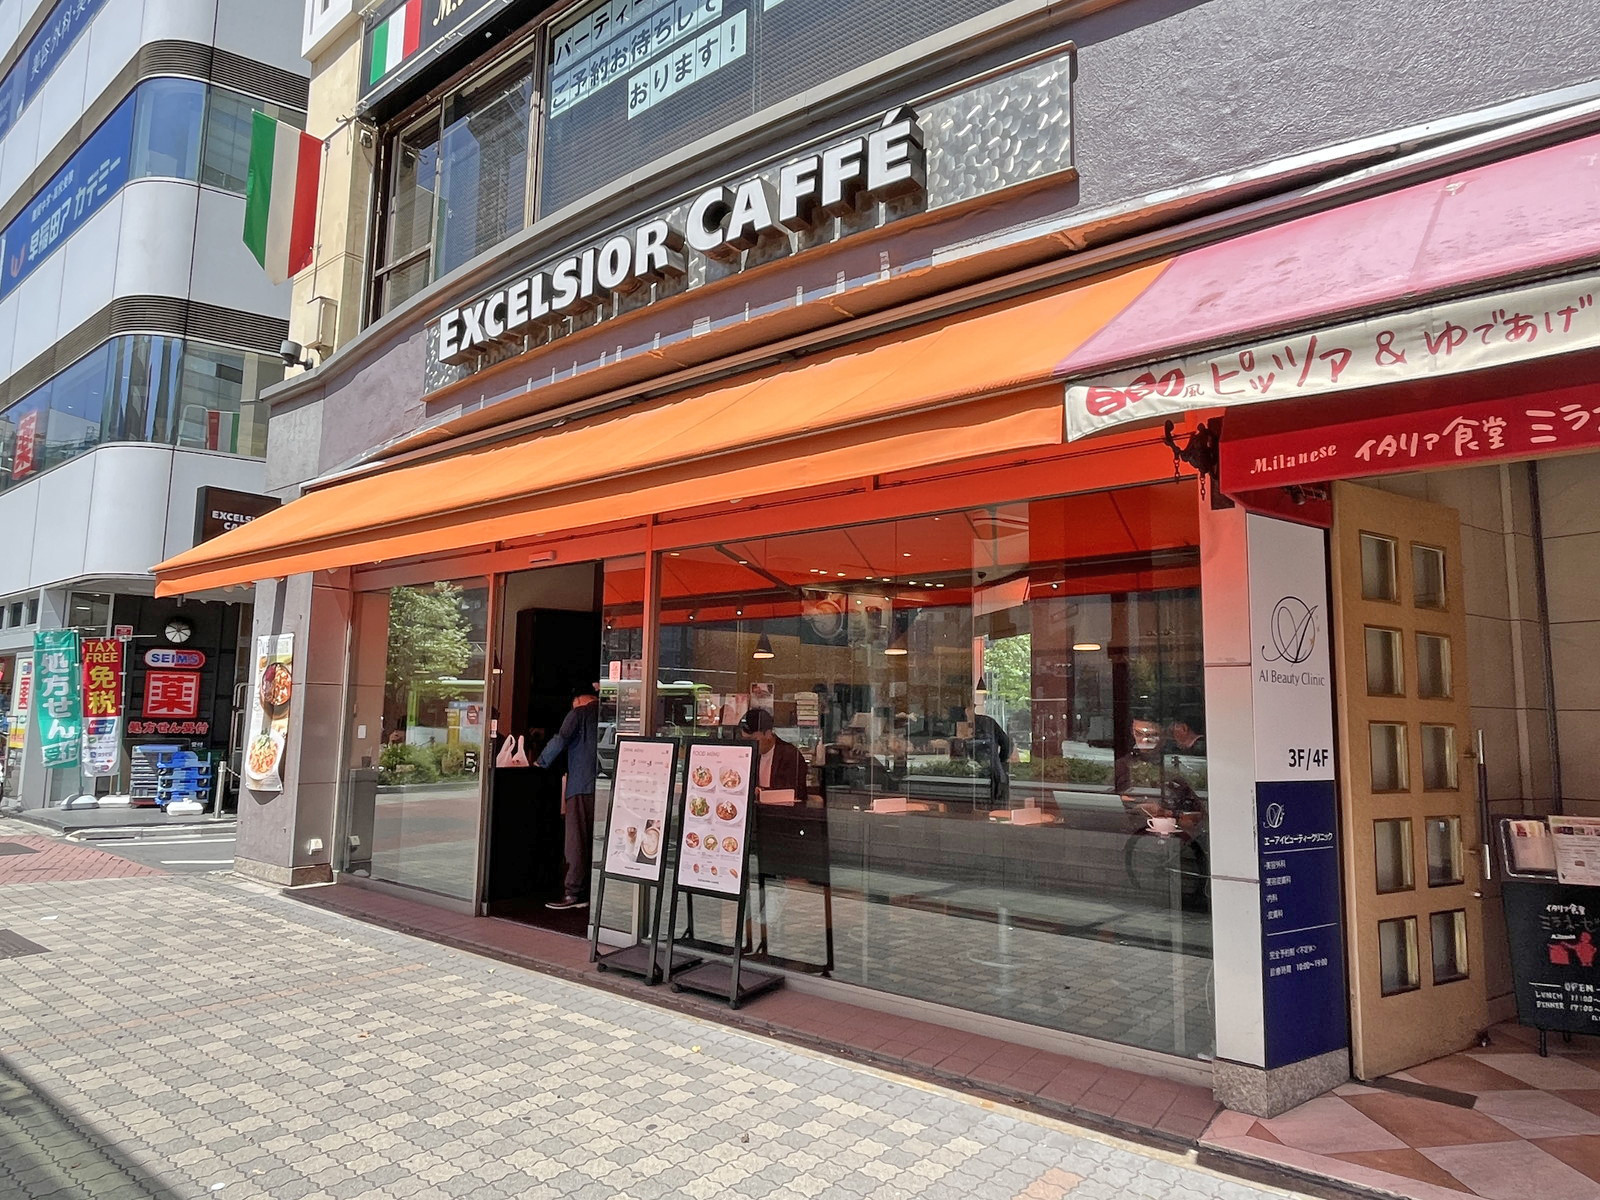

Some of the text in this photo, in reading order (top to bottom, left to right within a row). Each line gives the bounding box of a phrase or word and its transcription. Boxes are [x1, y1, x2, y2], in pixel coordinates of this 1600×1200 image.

[629, 24, 736, 110] おります!
[28, 157, 121, 261] 早稲田アカデミー
[438, 107, 914, 364] EXCELSIOR CAFFÉ
[1375, 330, 1408, 367] &
[1424, 293, 1593, 356] ゆであげ
[1525, 403, 1600, 444] ミラ
[86, 652, 119, 663] FREE
[87, 641, 116, 653] TAX
[151, 653, 200, 666] SEIMS
[88, 665, 117, 715] 免税
[148, 674, 195, 713] 薬
[1271, 670, 1300, 687] Beauty
[1301, 672, 1326, 687] Clinic
[41, 652, 75, 740] 処方せん
[127, 721, 209, 734] 処方せん受付
[1288, 748, 1329, 771] 3F/4F
[1535, 990, 1563, 1000] LUNCH
[1564, 982, 1594, 993] OPEN
